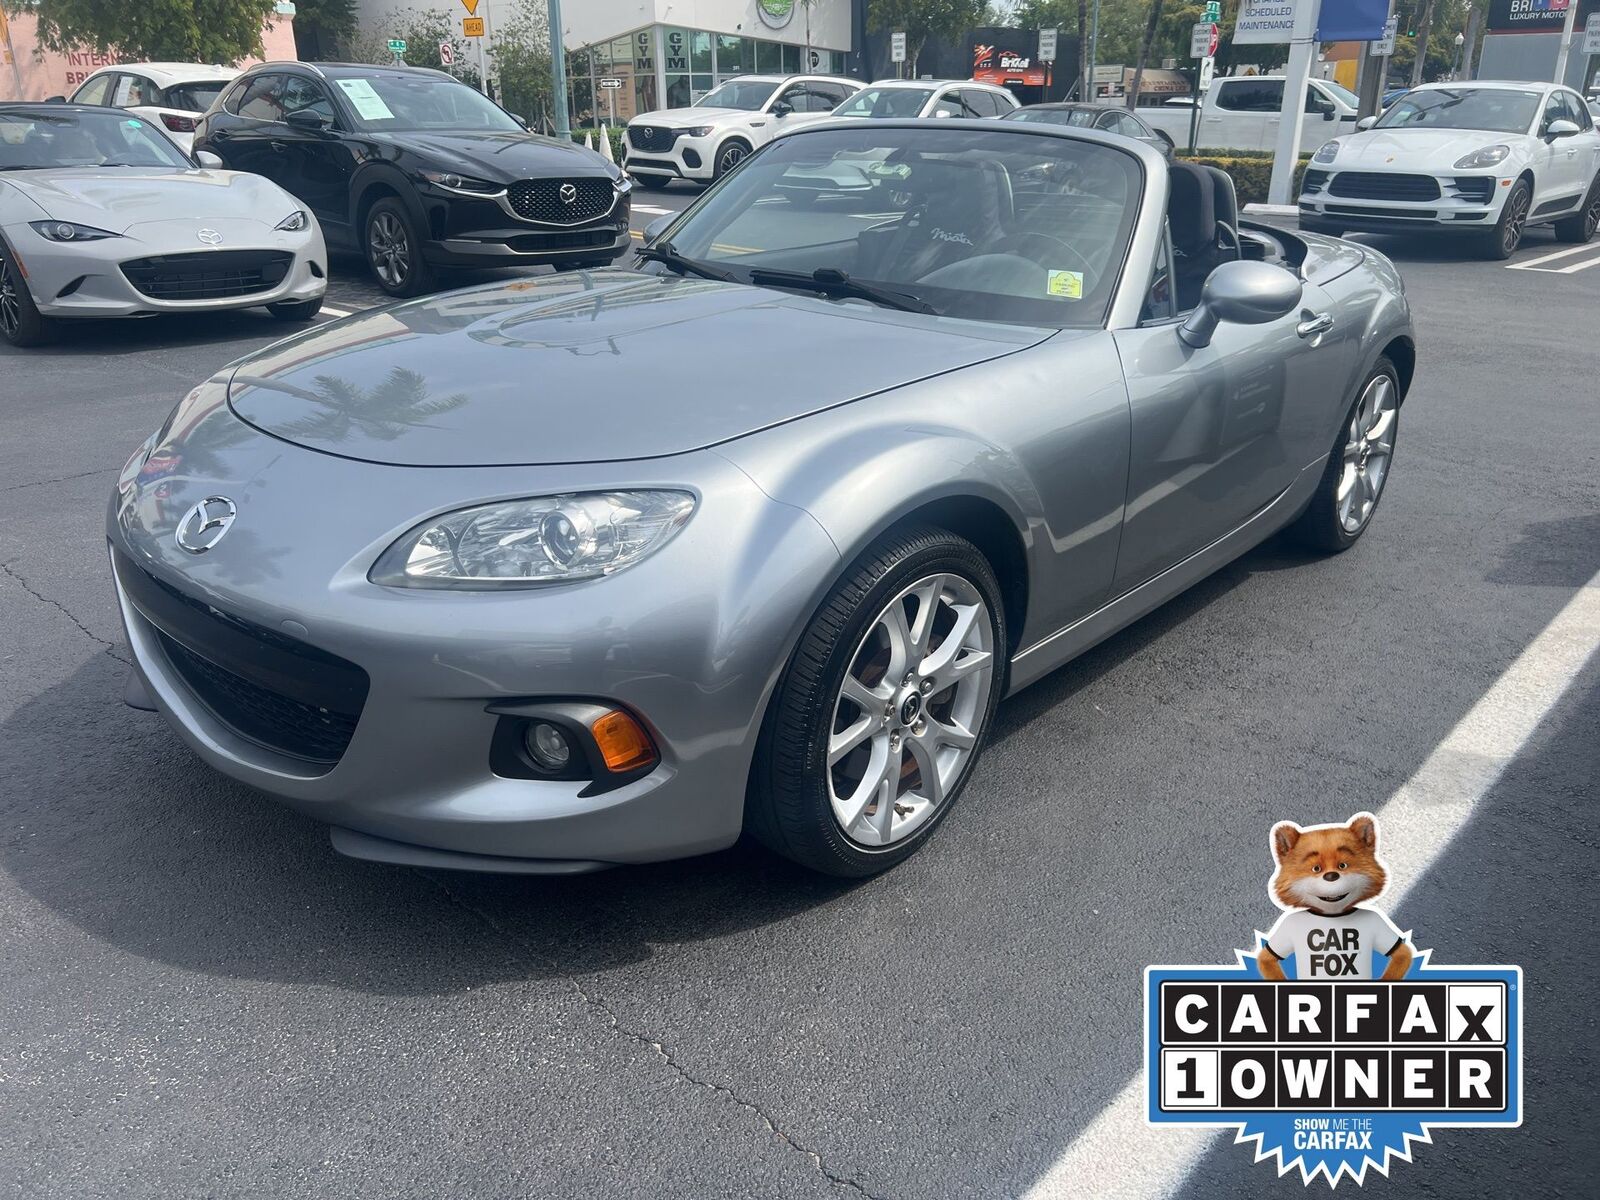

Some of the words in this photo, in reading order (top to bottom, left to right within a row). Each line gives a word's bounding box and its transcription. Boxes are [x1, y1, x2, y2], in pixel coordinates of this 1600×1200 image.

[1245, 7, 1292, 17] SCHEDULED
[1509, 12, 1540, 20] LUXURY
[637, 32, 652, 69] GYM
[667, 32, 686, 69] GYM
